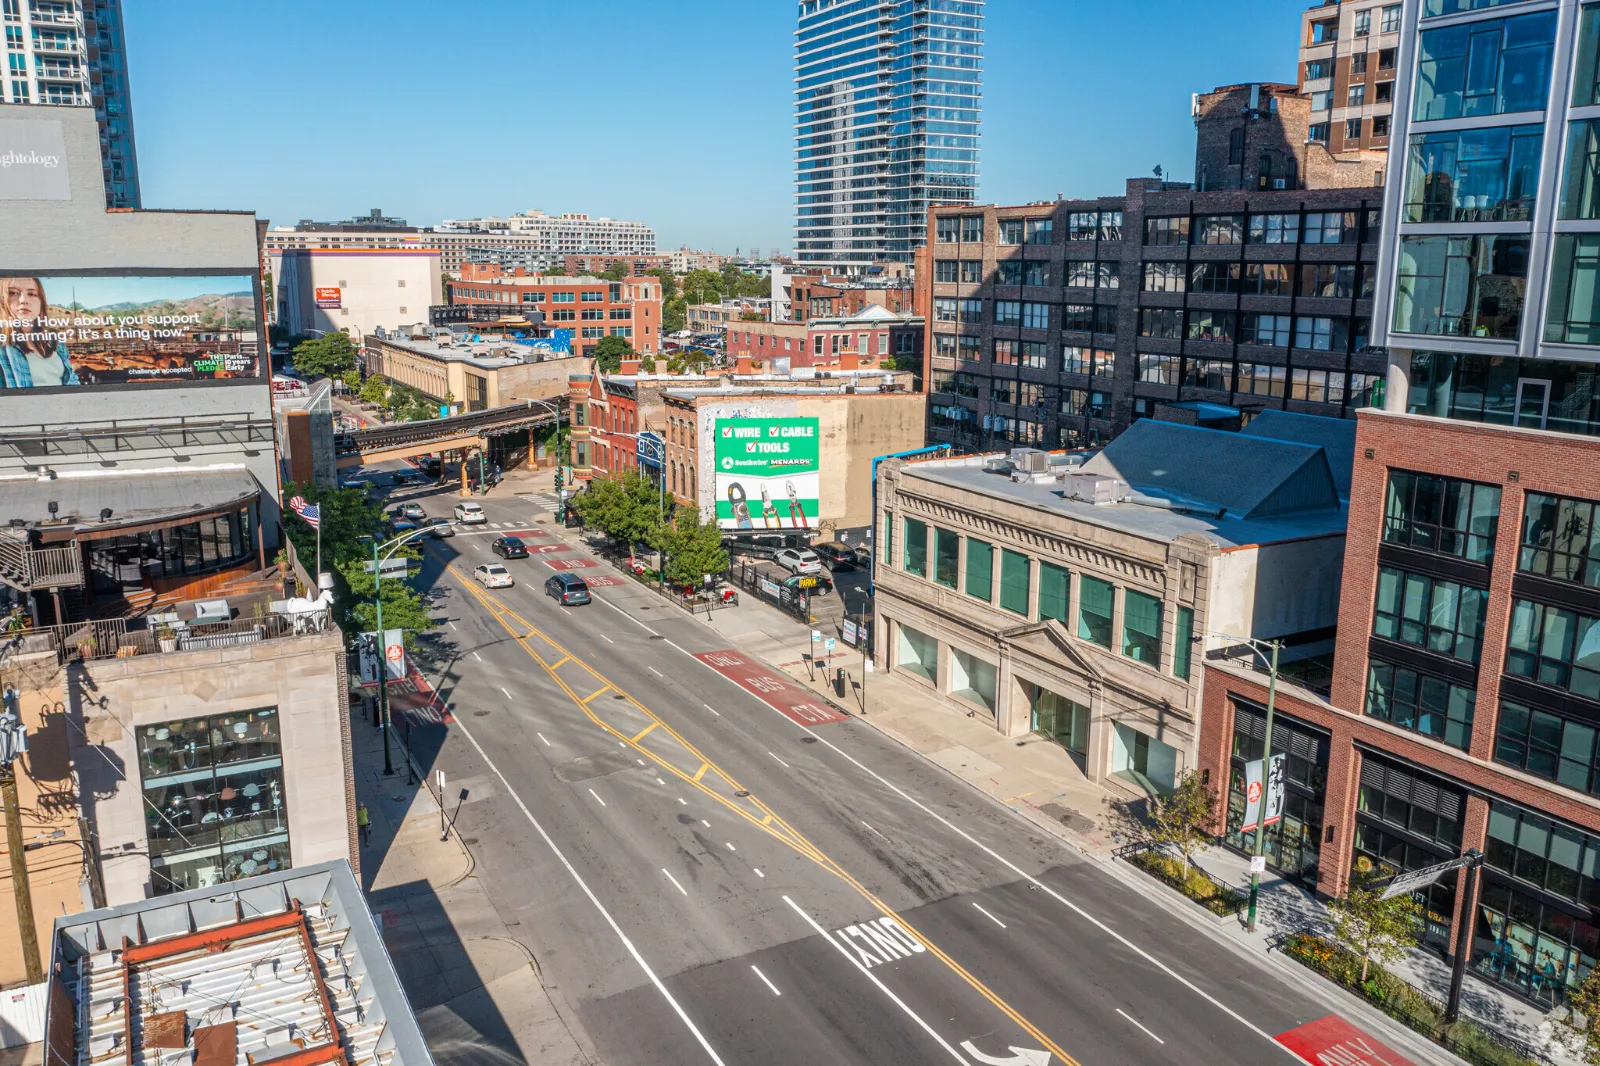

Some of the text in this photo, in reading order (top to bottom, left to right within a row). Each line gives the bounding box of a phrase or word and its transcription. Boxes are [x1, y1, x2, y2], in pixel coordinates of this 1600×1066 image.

[37, 315, 69, 327] How
[74, 315, 115, 326] about
[118, 316, 143, 327] you
[147, 313, 201, 326] support
[11, 329, 74, 343] farming?
[103, 331, 112, 339] a
[115, 328, 150, 341] thing
[161, 366, 192, 374] accepted
[734, 427, 761, 438] WIRE
[781, 426, 814, 438] CABLE
[757, 442, 790, 453] TOOLS
[586, 575, 614, 587] BUS
[744, 676, 786, 693] BUS
[791, 703, 836, 722] CTA
[836, 917, 926, 968] ONLY
